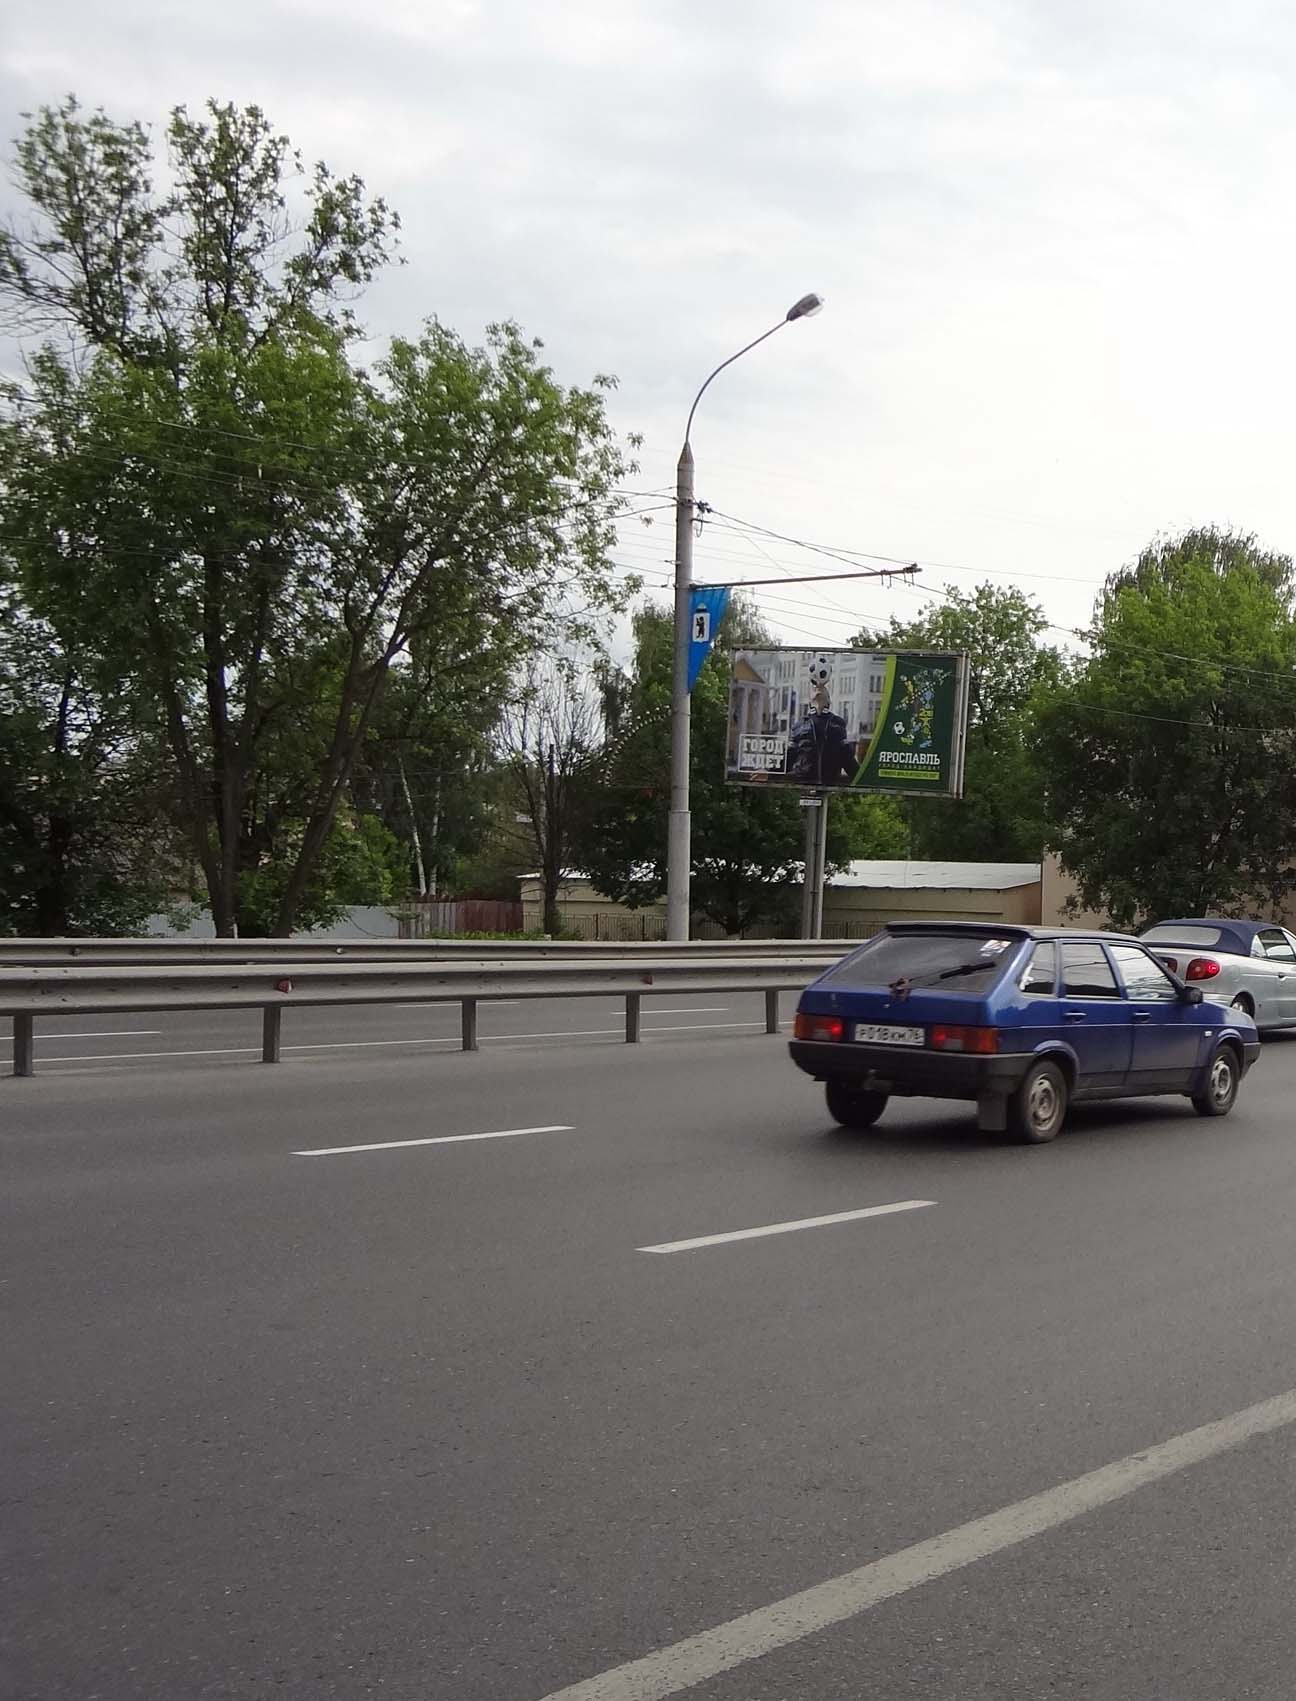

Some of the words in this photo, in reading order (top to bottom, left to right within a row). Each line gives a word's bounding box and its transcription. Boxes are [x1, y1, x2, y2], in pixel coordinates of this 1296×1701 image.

[743, 739, 784, 754] ГОРОД
[741, 753, 784, 769] ЖДЕТ
[879, 751, 941, 765] ЯРОСЛАВЛЬ
